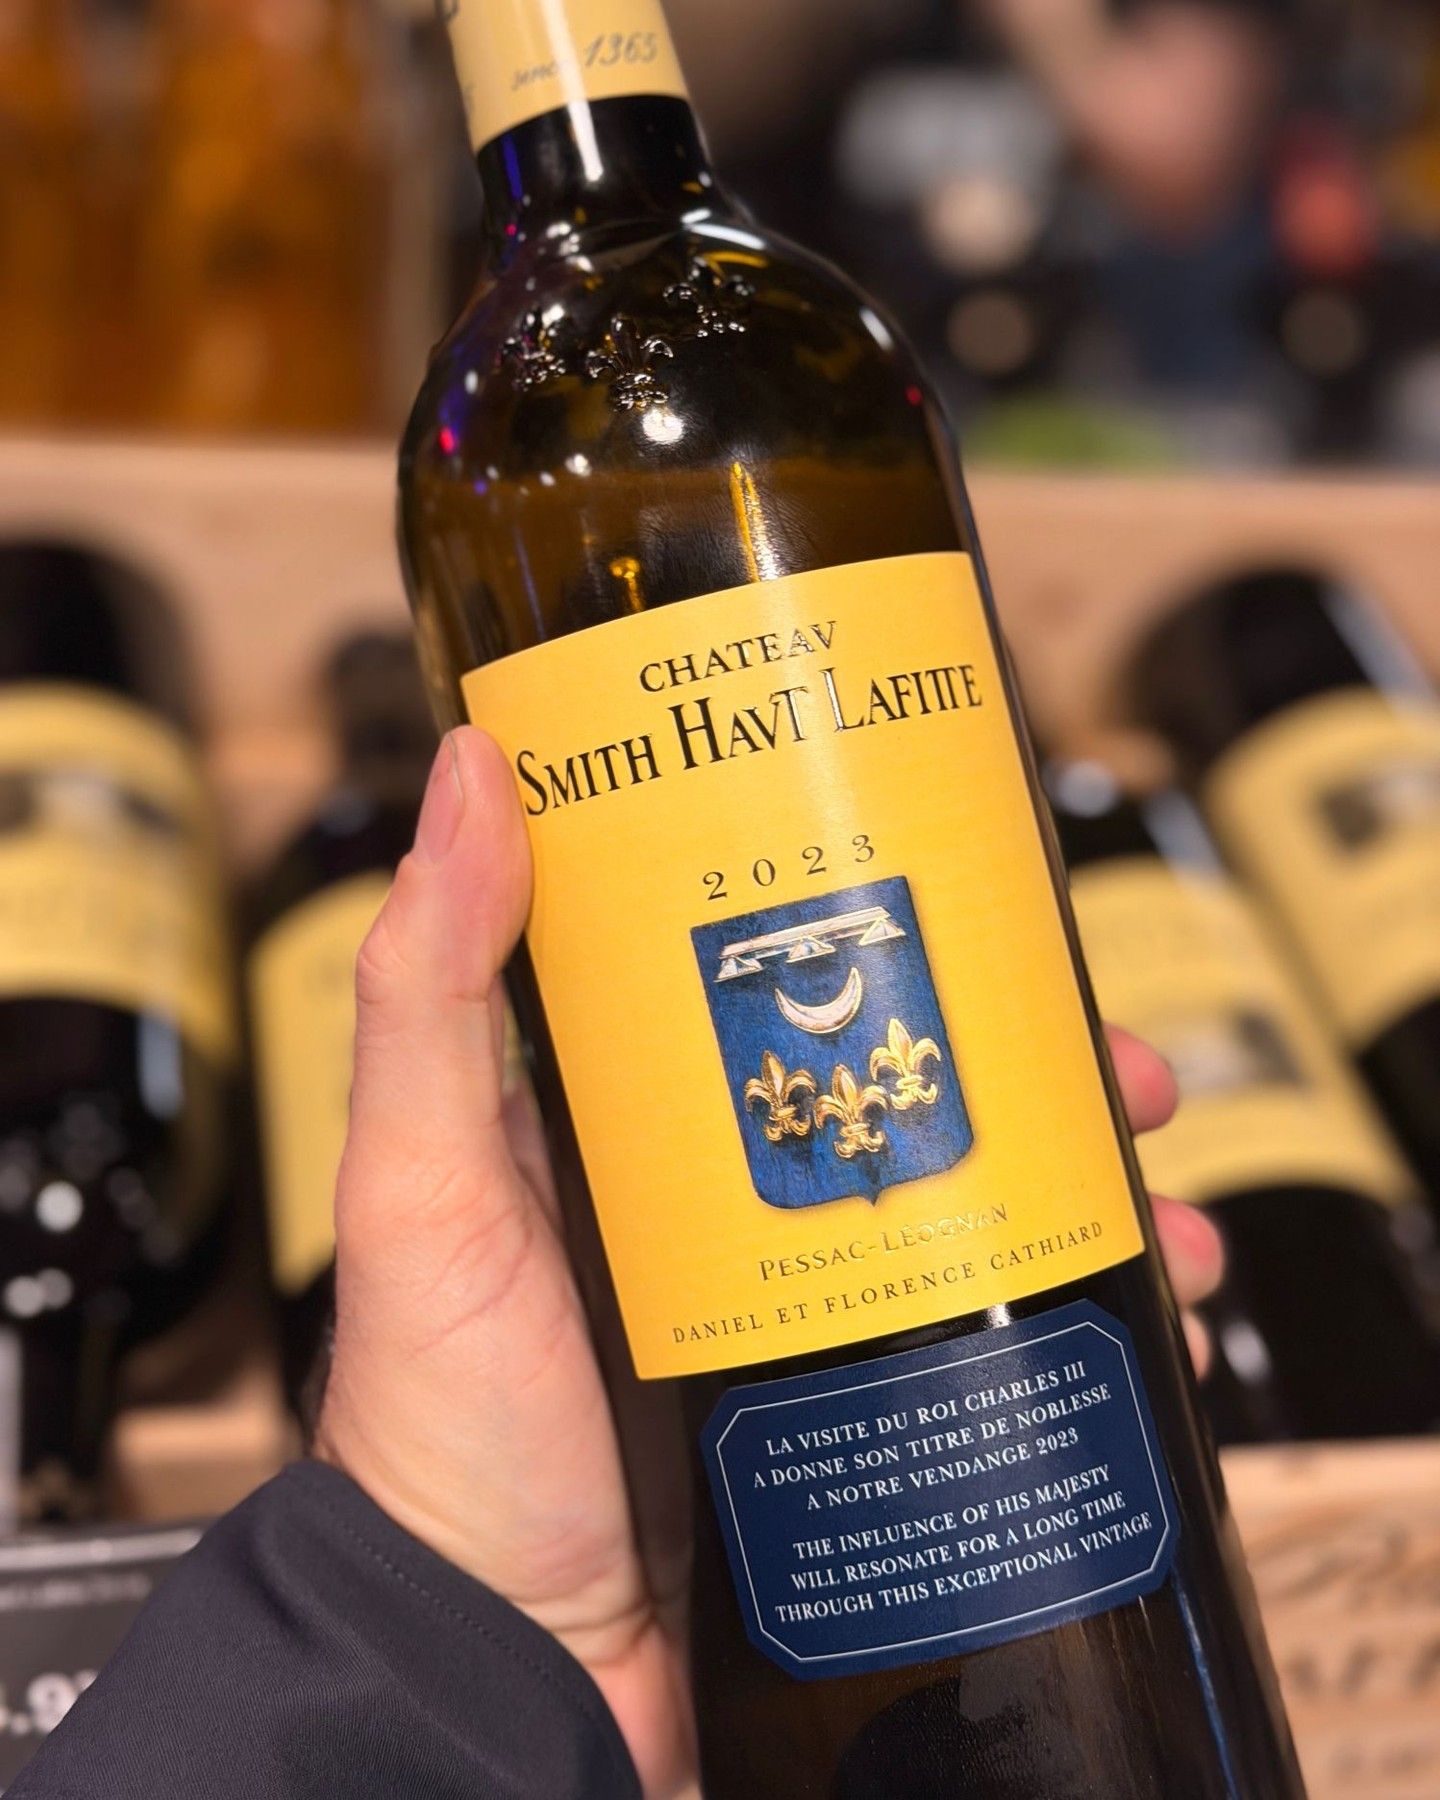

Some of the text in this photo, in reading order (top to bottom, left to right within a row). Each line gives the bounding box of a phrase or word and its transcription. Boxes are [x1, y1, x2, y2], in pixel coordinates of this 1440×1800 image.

[584, 32, 658, 67] 1365
[639, 620, 837, 692] CHATEAV
[516, 733, 662, 815] SMITH
[667, 686, 808, 770] HAVT
[702, 834, 876, 900] 2023
[673, 1221, 1103, 1343] DANIEL ET FLORENCE CATHIARD
[753, 1383, 1112, 1489] A DONNE SON TITRE DE NOBLESSE
[766, 1360, 1086, 1457] LA VISITE DU ROI CHARLES III
[793, 1463, 1111, 1561] THE INFLUENCE OF HIS MAJESTY
[806, 1427, 1080, 1511] A NOTRE VENDANGE 2023
[774, 1511, 1153, 1624] THROUGH THIS EXCEPTIONAL VINTAGE
[790, 1490, 1126, 1593] WILL RESONATE FOR A LONG TIME
